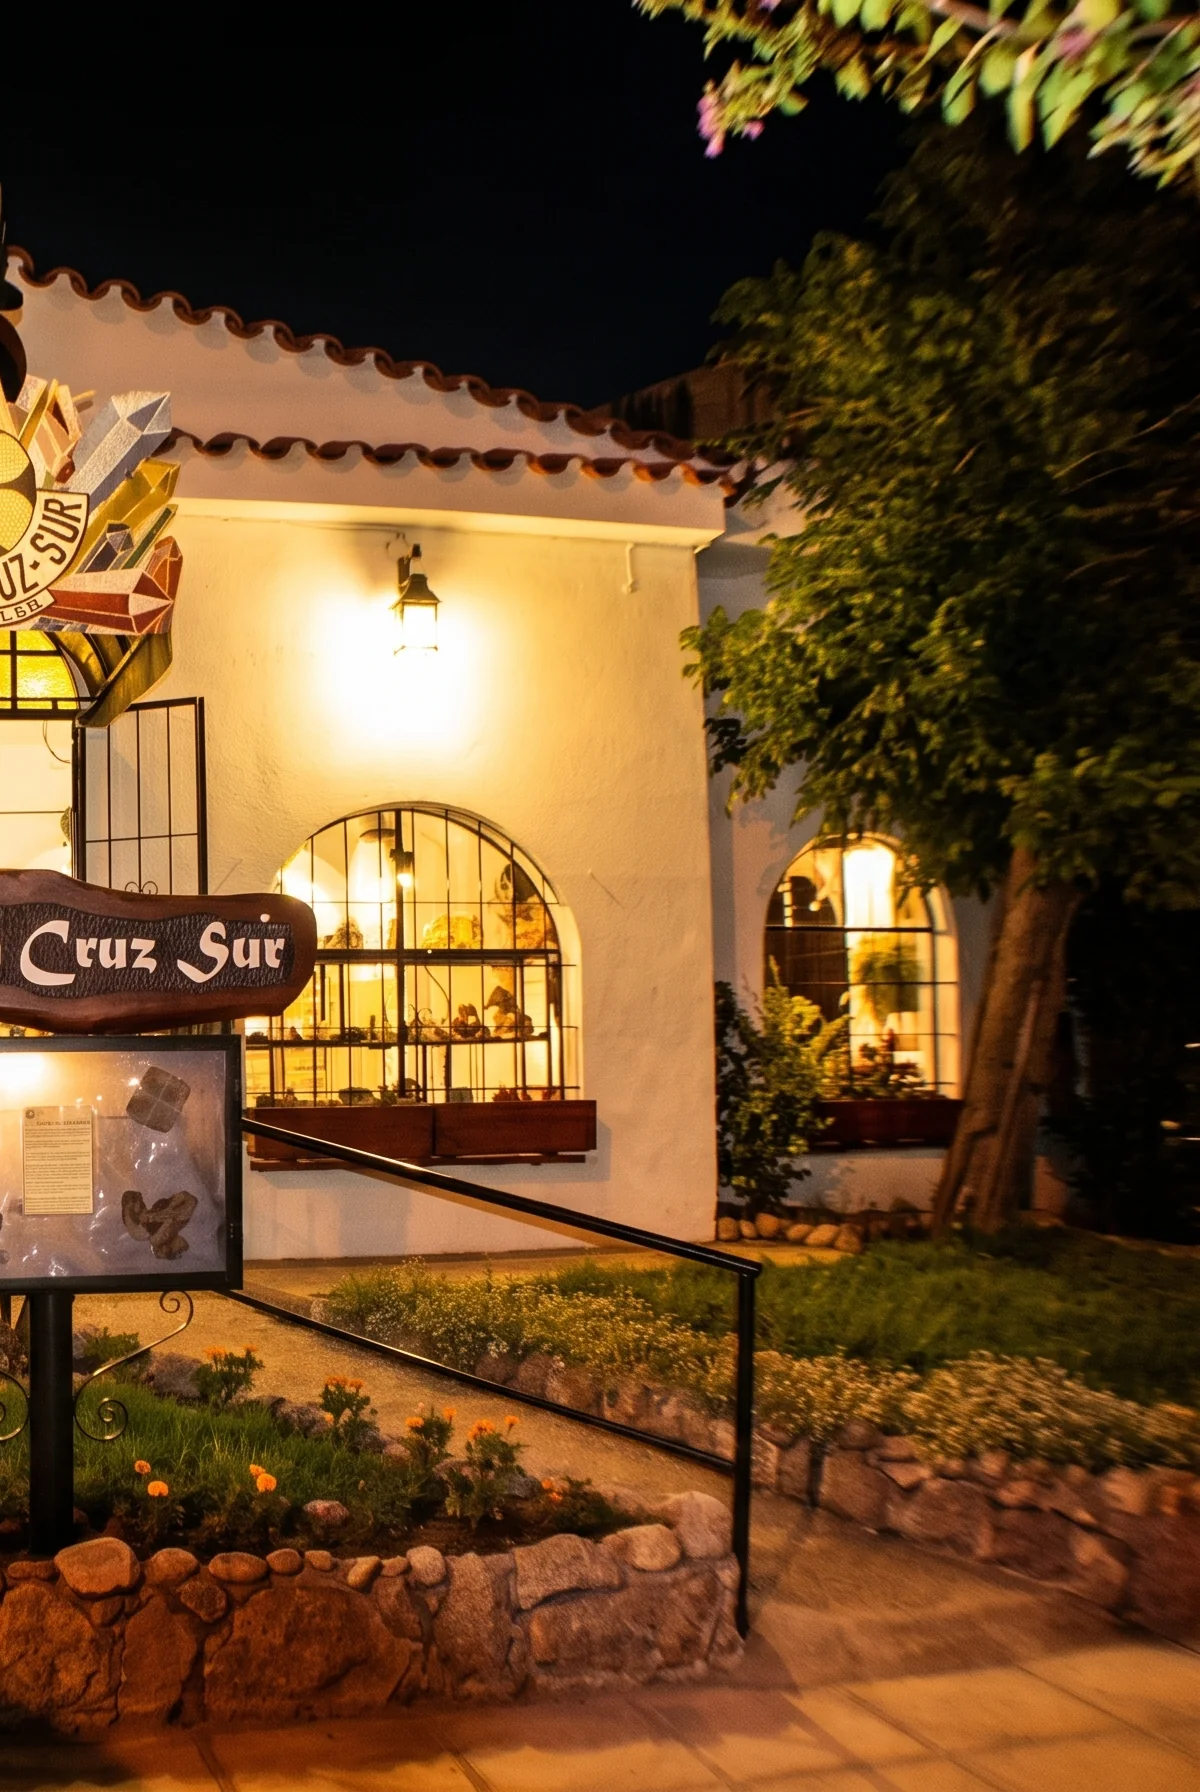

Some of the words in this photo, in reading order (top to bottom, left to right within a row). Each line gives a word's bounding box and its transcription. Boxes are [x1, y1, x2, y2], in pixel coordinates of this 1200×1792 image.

[29, 498, 83, 565] SUR
[19, 920, 156, 986] Cruz
[177, 914, 285, 984] Sur
